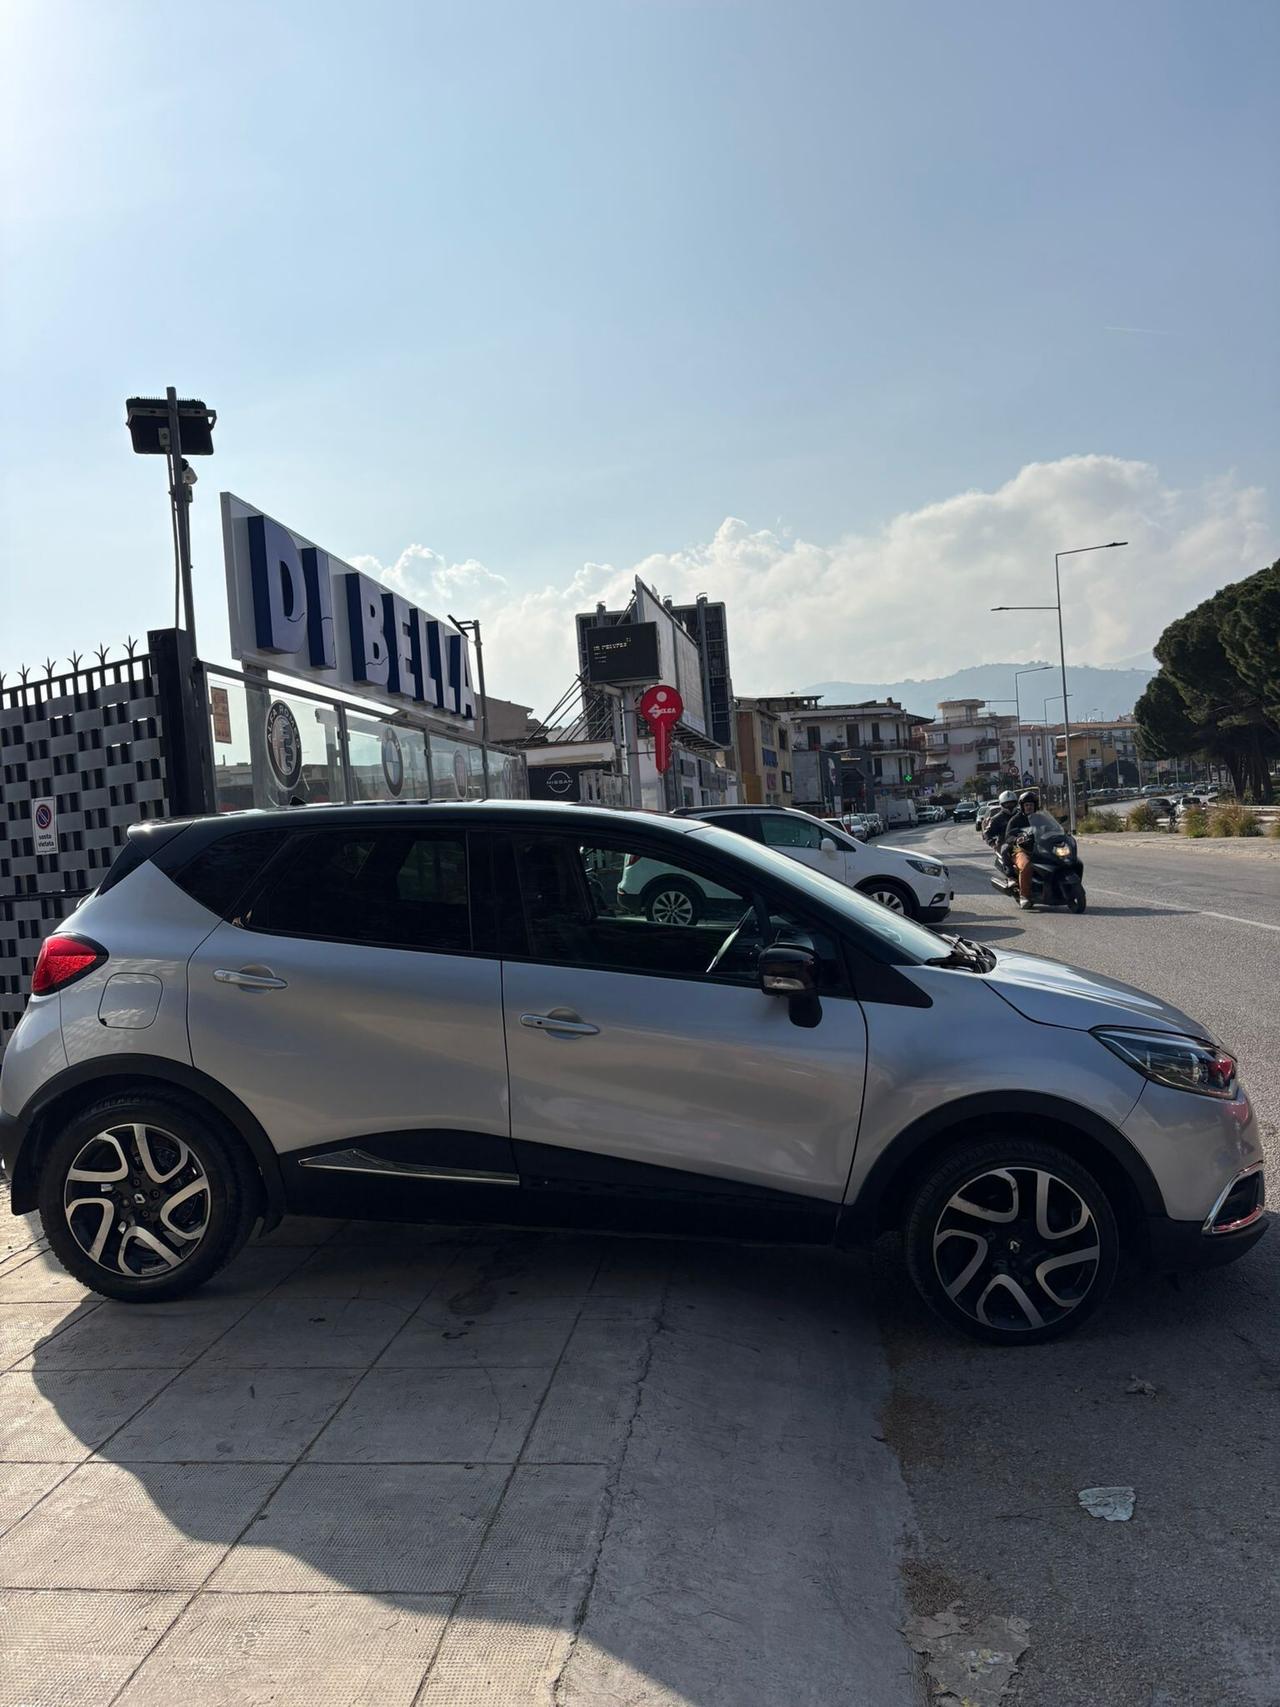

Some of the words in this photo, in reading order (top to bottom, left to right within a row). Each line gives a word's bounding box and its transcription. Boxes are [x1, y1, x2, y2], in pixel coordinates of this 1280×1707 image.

[248, 515, 336, 669] DI
[346, 573, 477, 720] BELLA
[38, 840, 54, 848] vietata
